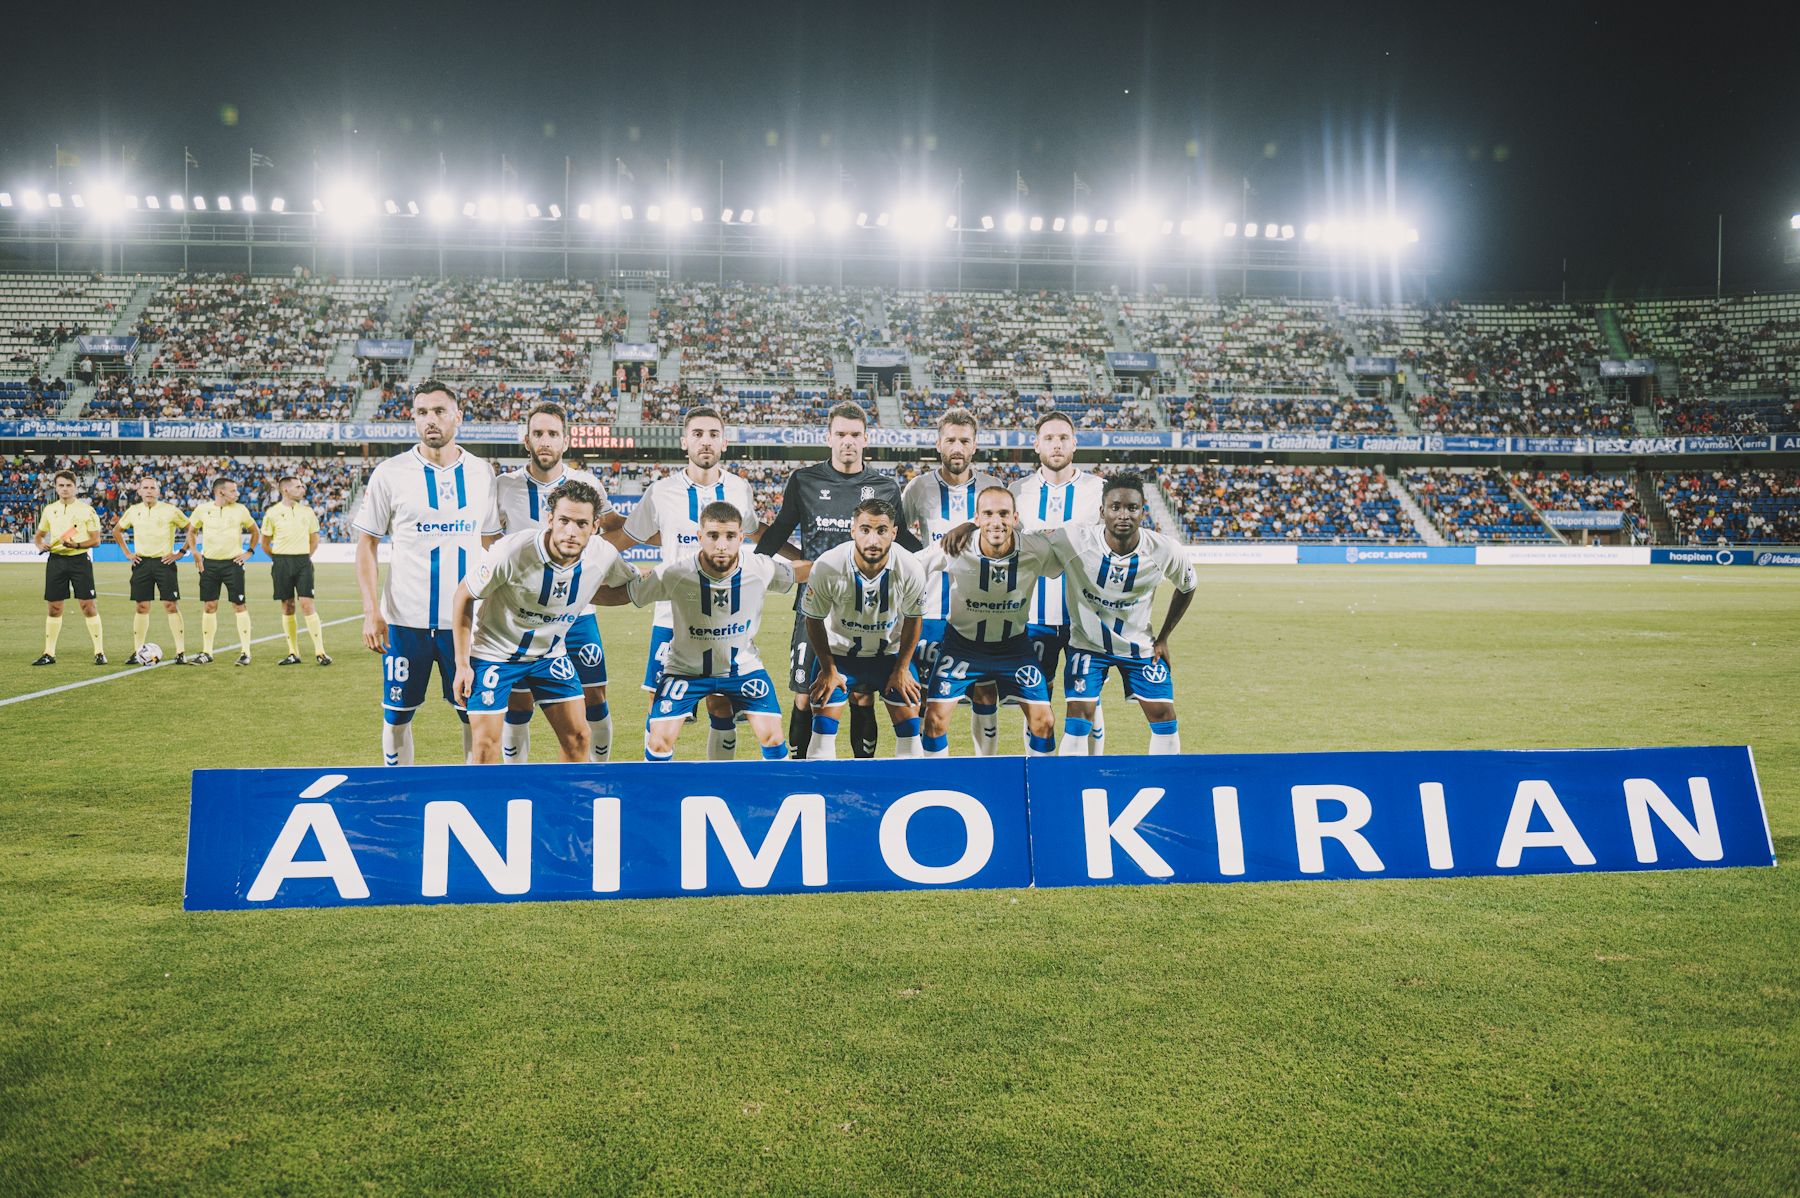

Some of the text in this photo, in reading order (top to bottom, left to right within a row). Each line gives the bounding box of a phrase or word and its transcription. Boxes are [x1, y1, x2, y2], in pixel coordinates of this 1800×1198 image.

[364, 422, 407, 437] GRUPO
[570, 426, 610, 437] OSCAR
[1112, 435, 1161, 444] CANARAGUA
[1669, 552, 1713, 562] hospiten
[797, 641, 807, 665] 1
[917, 639, 940, 662] 16
[385, 655, 409, 682] 18
[936, 655, 970, 679] 24
[1071, 652, 1091, 675] 11
[482, 665, 500, 689] 6
[661, 676, 689, 700] 10
[246, 774, 1725, 902] ÁNIMO KIRIAN
